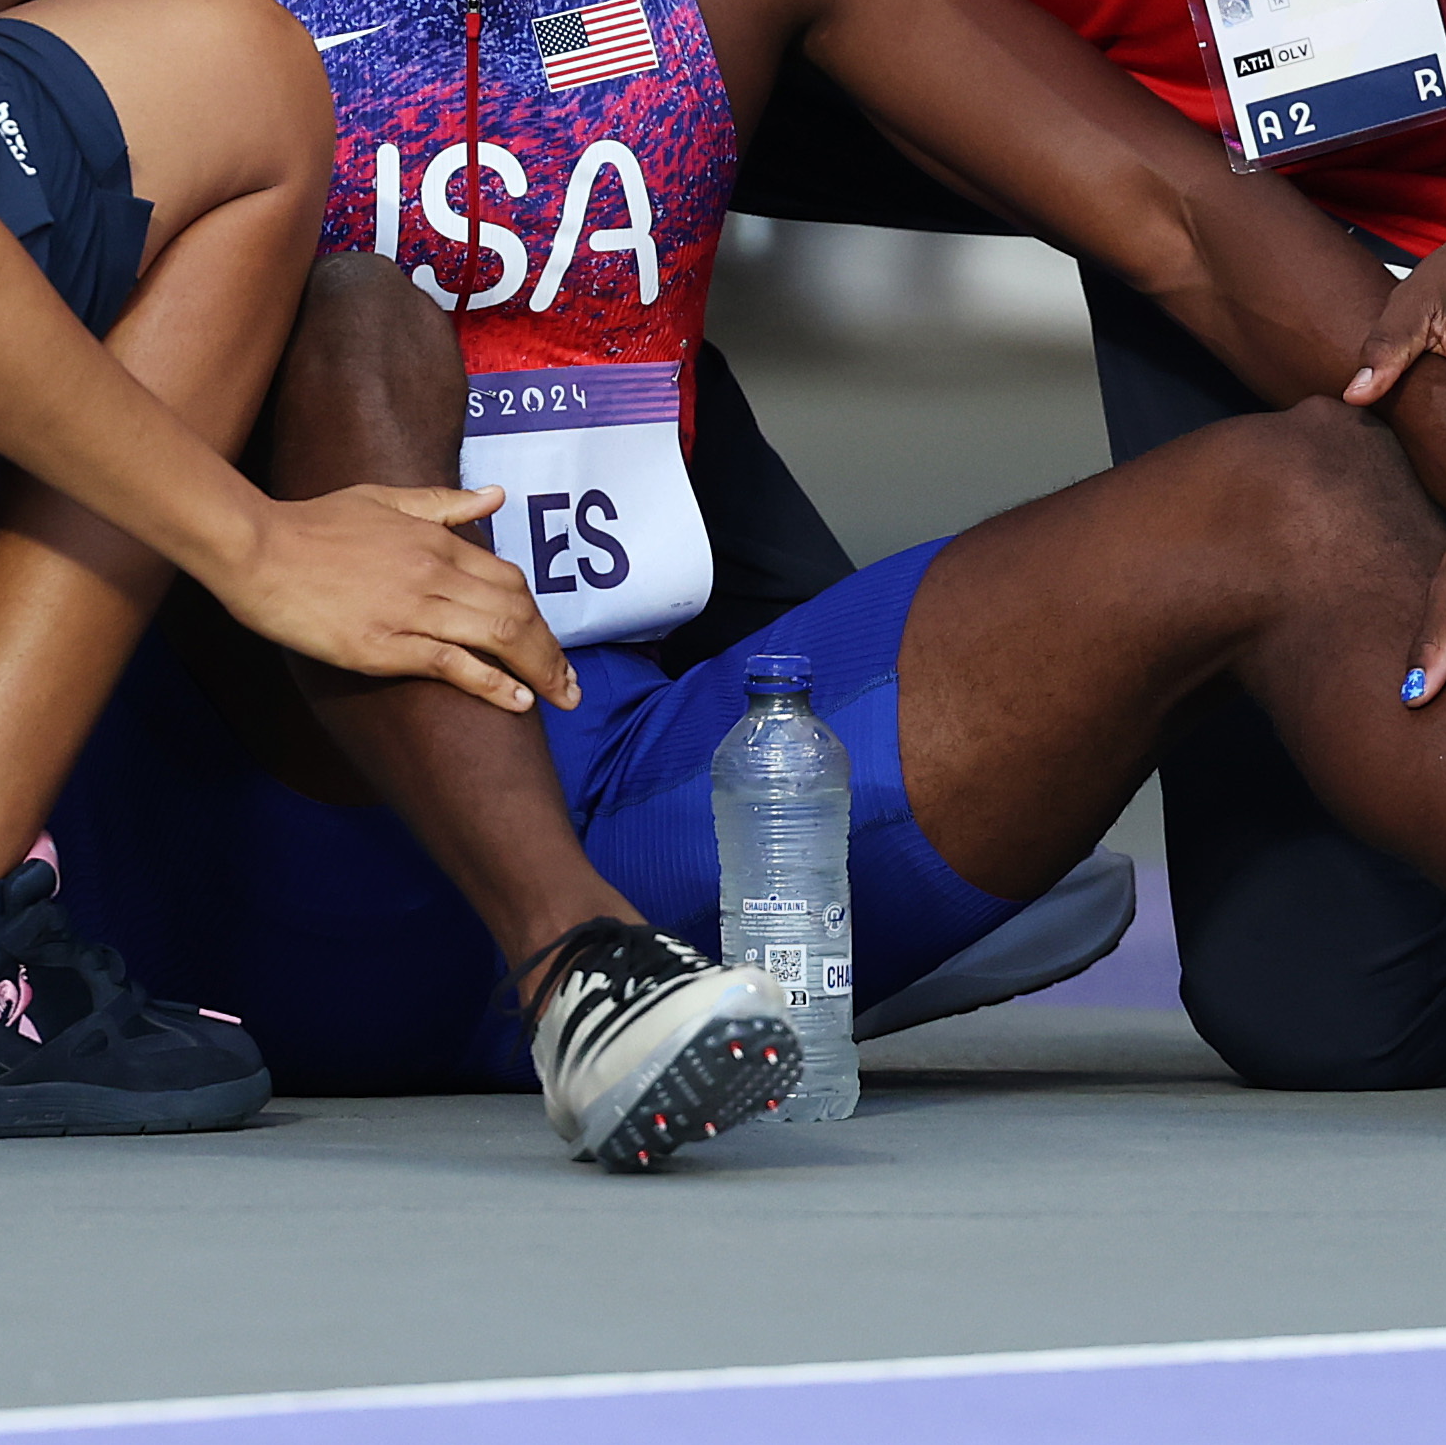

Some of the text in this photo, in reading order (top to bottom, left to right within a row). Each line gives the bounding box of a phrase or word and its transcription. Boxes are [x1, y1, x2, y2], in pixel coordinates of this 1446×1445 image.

[1238, 44, 1310, 75] ATH OLV
[1257, 67, 1444, 145] A 2 R
[498, 383, 588, 417] 2024
[743, 901, 806, 912] CHAUDFONTAINE
[827, 965, 852, 988] CHA
